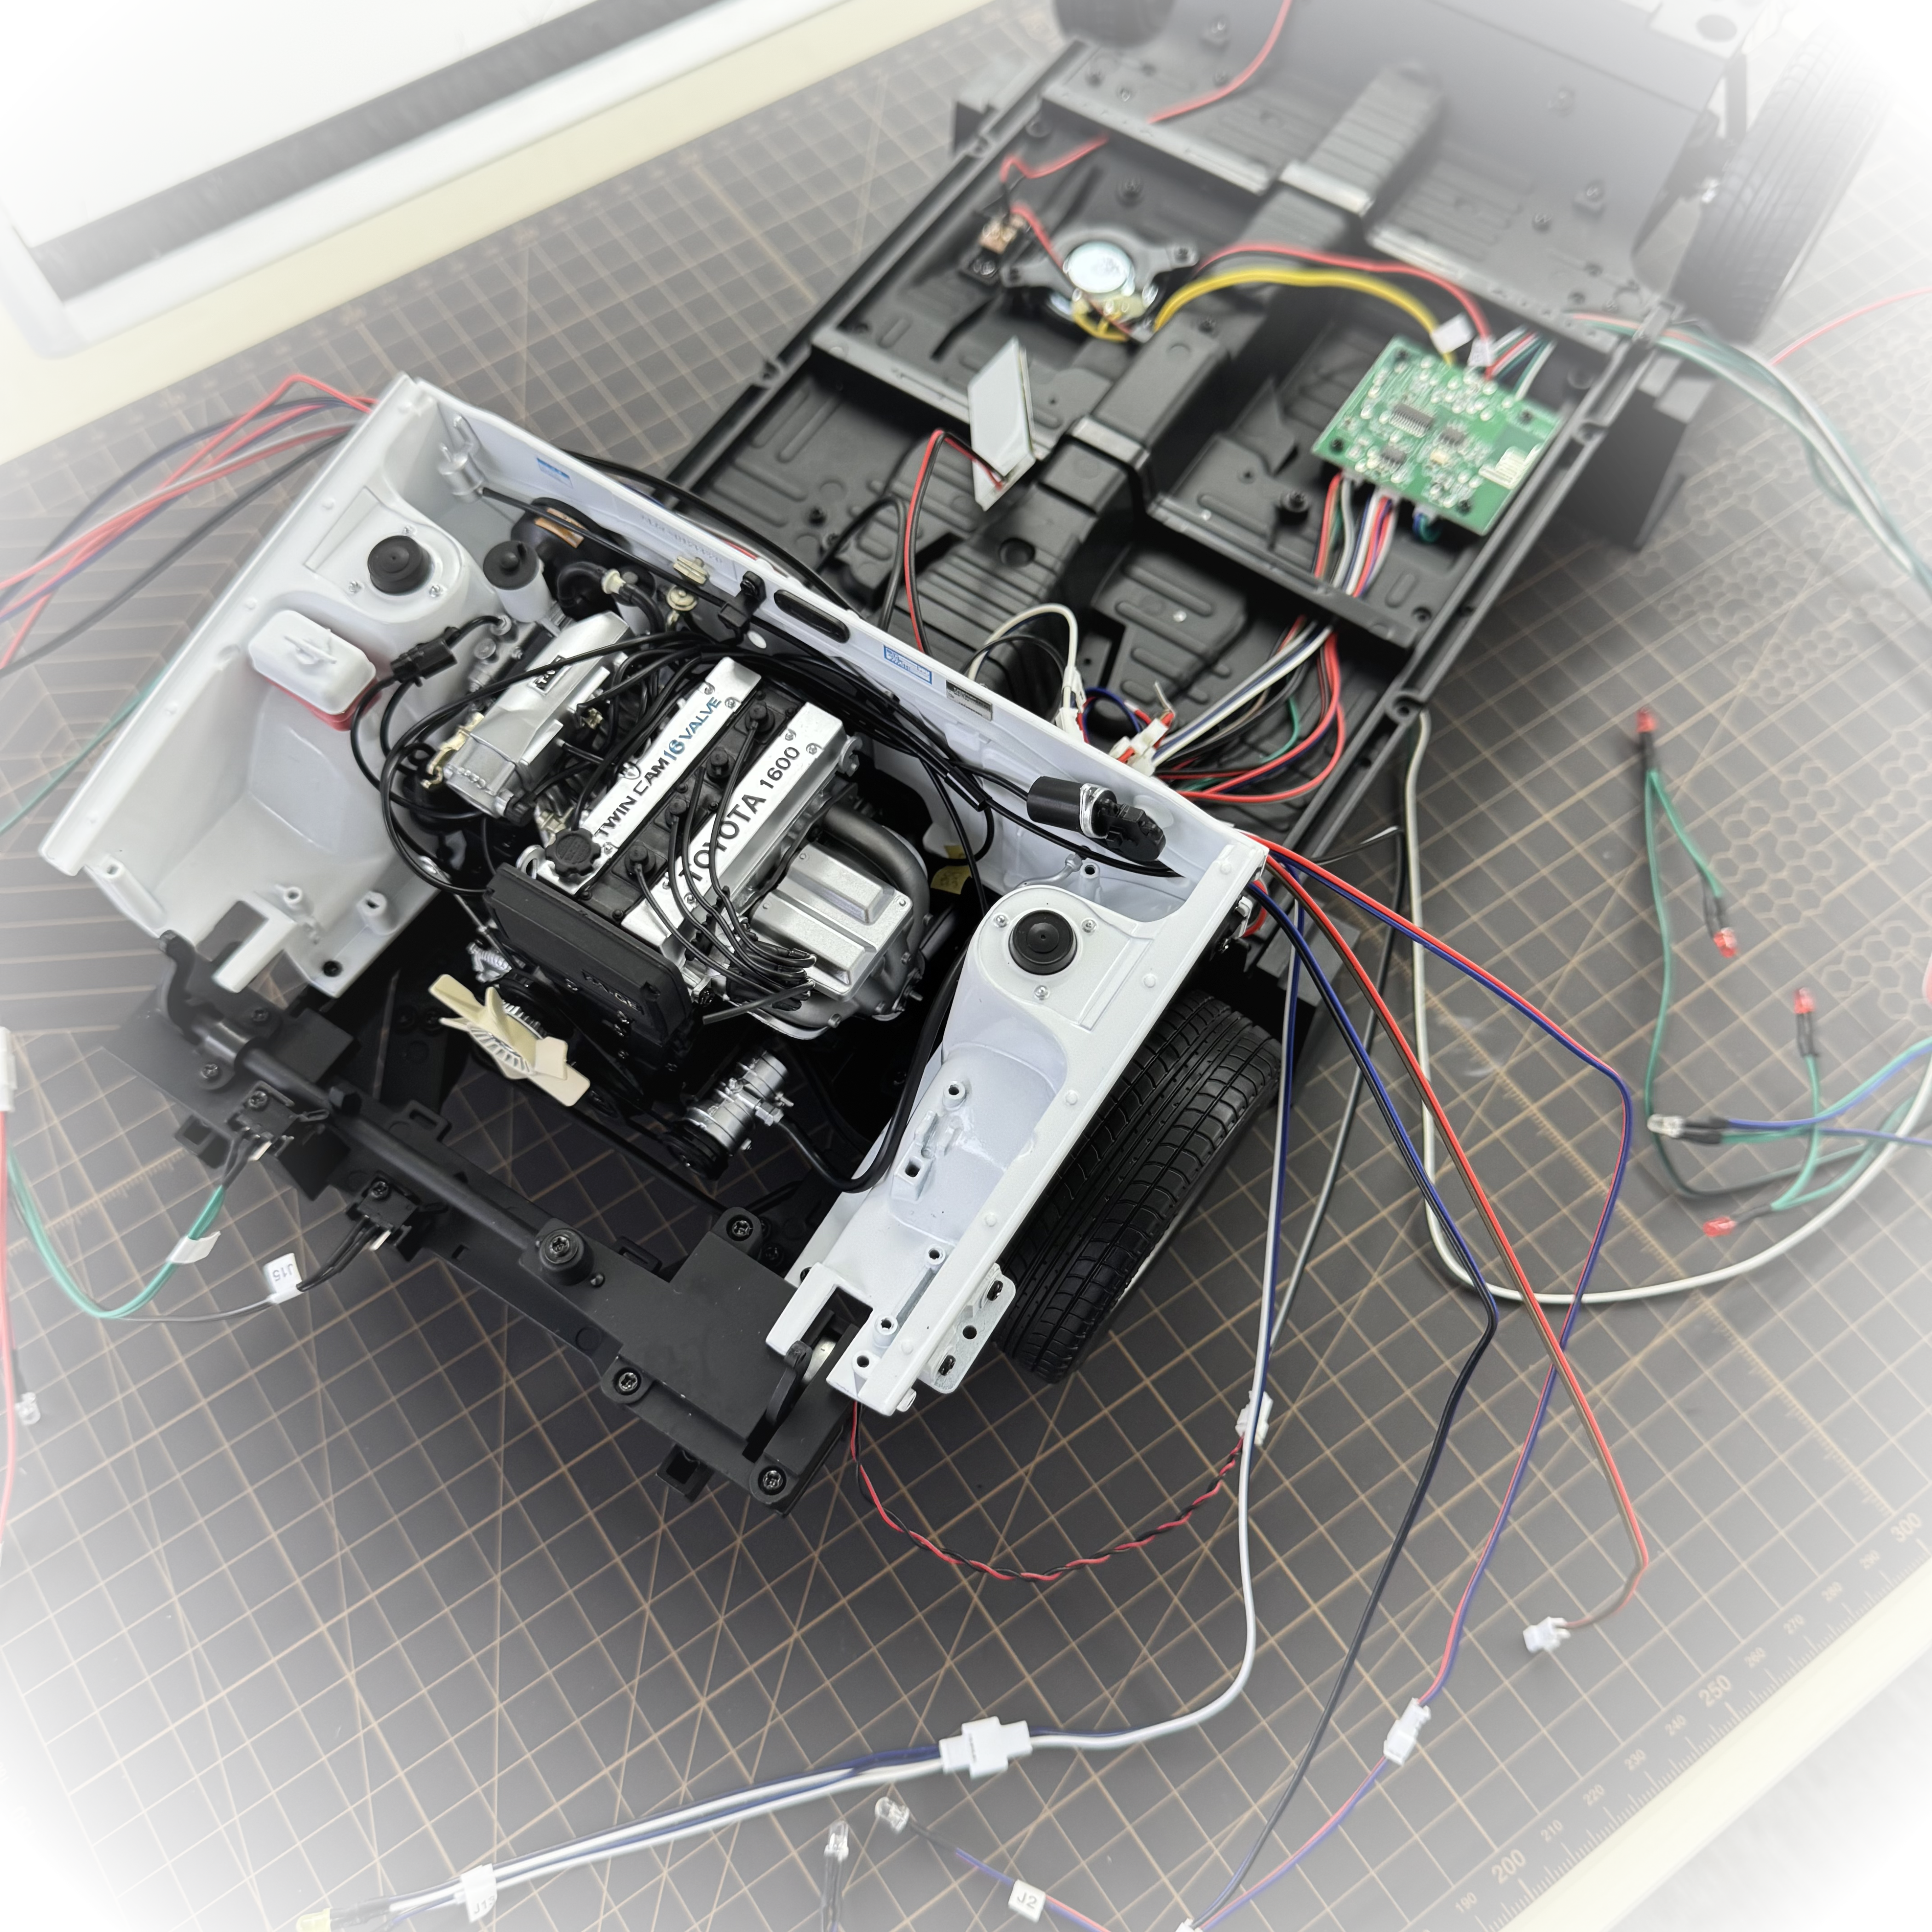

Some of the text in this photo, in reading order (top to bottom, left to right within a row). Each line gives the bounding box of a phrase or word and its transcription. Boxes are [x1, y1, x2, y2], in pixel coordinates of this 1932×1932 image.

[594, 696, 722, 837] TWIN CAM 16 VALVE
[678, 747, 800, 882] TOYOTA 1600
[272, 1263, 293, 1282] J15
[1890, 1512, 1922, 1543] 300
[1698, 1675, 1732, 1707] 250
[1665, 1714, 1686, 1736] 240
[1624, 1749, 1646, 1771] 230
[1583, 1784, 1604, 1806] 220
[9, 1806, 36, 1842] 150
[1541, 1820, 1563, 1842] 210
[1491, 1849, 1526, 1885] 200
[1017, 1892, 1037, 1909] J2
[1455, 1892, 1478, 1914] 190
